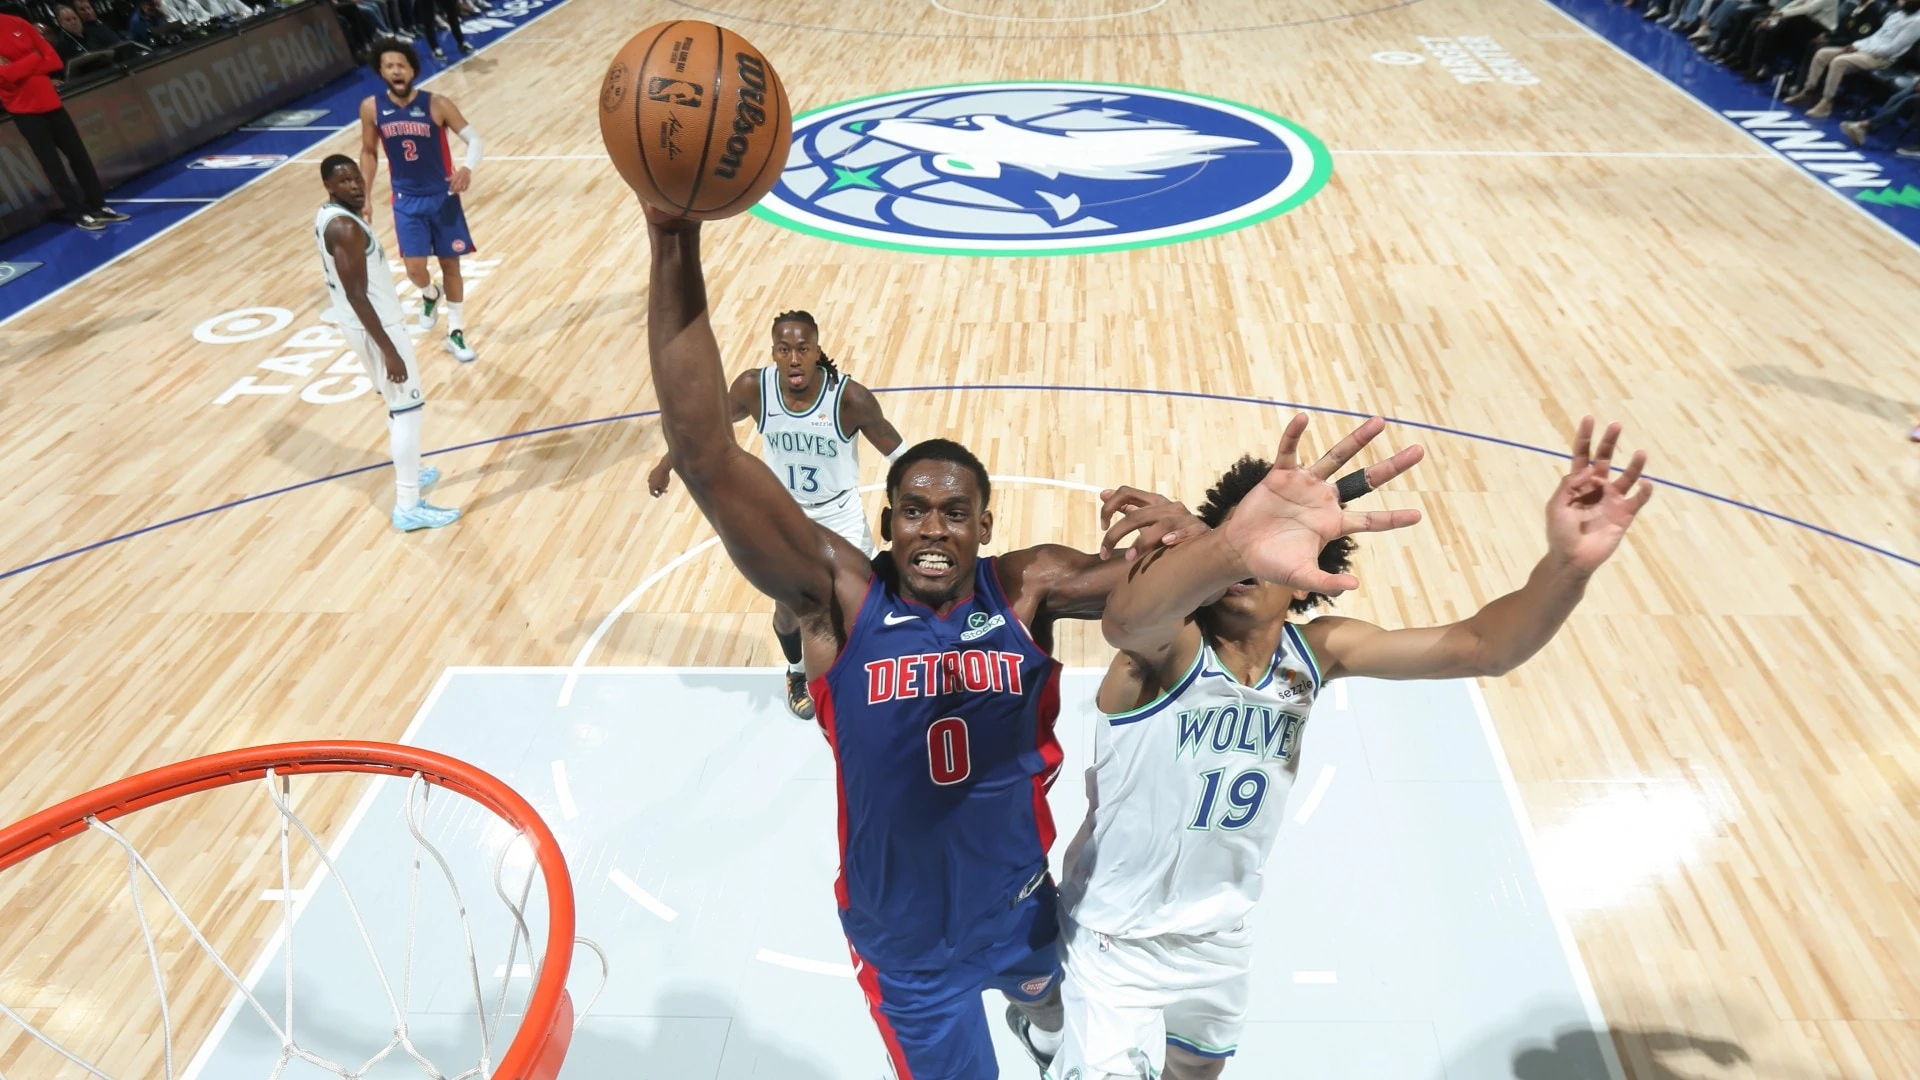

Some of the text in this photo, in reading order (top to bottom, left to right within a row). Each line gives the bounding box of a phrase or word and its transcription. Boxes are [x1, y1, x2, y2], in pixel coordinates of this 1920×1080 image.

[147, 21, 344, 139] FOR THE PACK
[381, 120, 431, 139] DETROIT
[714, 52, 767, 180] Wilson
[402, 139, 419, 162] 2
[1722, 110, 1892, 188] MINN
[765, 432, 838, 458] WOLVES
[785, 464, 820, 493] 13
[962, 615, 1003, 640] StockX
[864, 650, 1024, 705] DETROIT
[1278, 679, 1313, 699] sezzle
[927, 717, 971, 785] 0
[1187, 766, 1270, 831] 19
